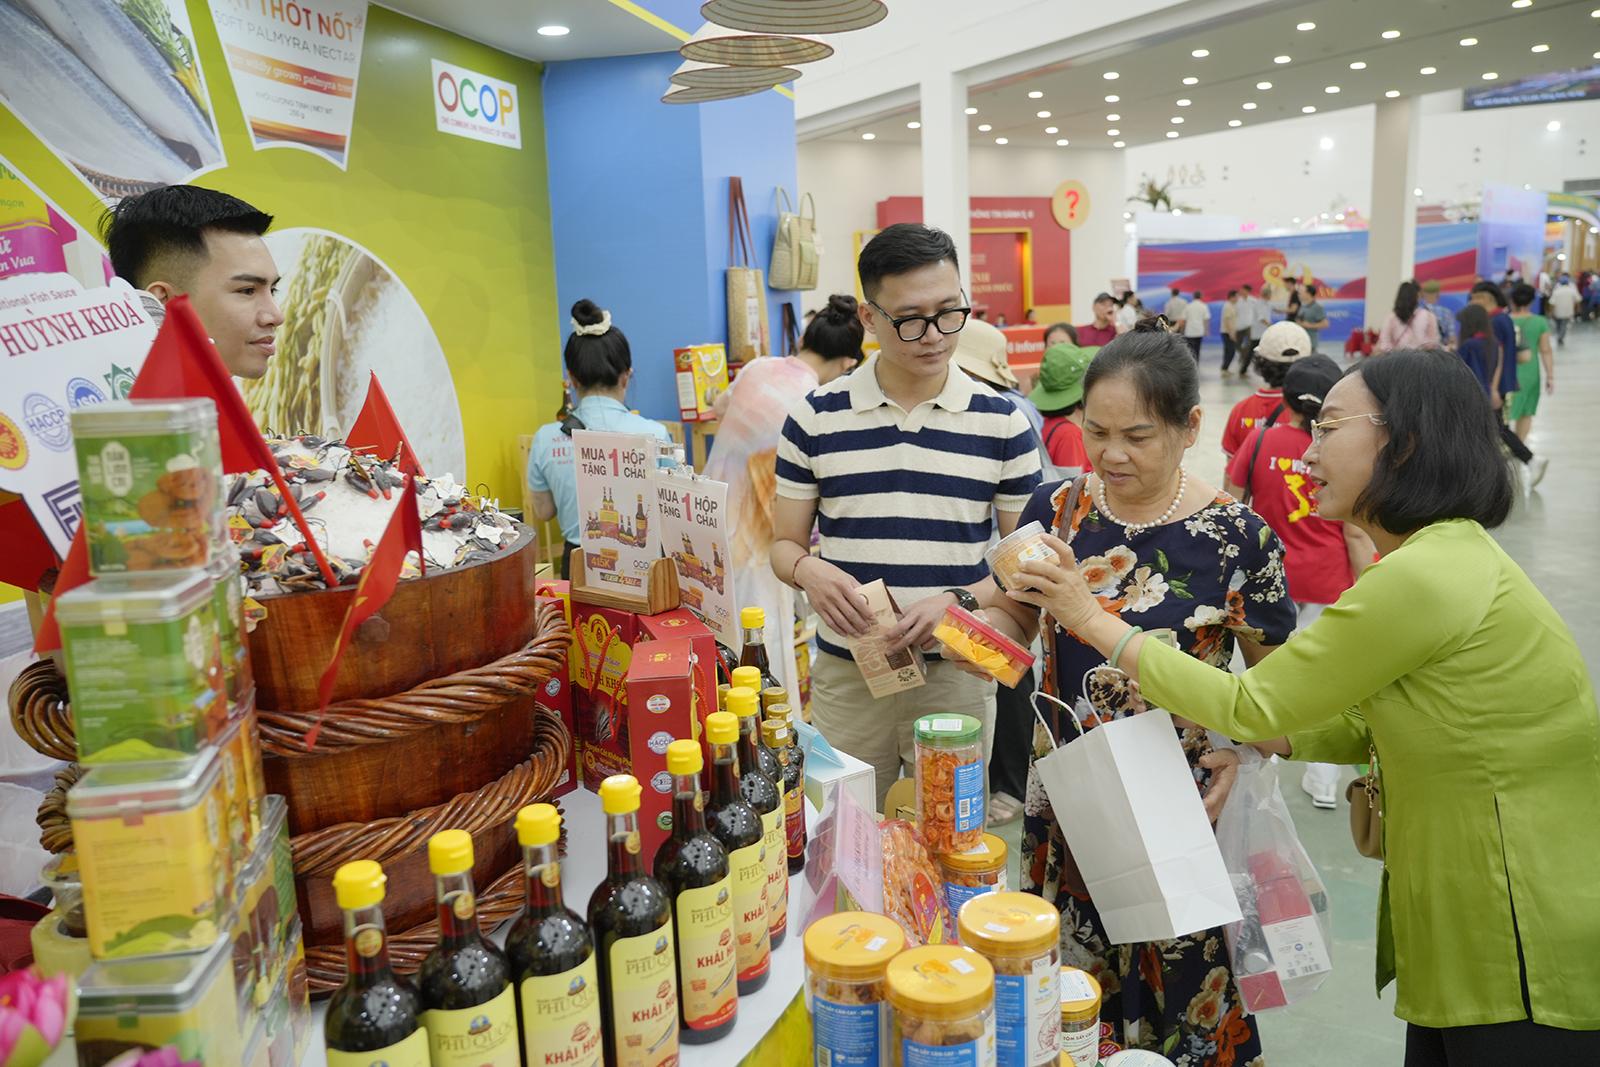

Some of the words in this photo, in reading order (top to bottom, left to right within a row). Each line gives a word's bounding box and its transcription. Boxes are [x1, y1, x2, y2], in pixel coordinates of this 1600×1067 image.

[248, 22, 310, 51] PALMYRA
[313, 44, 356, 64] NECTAR
[438, 71, 514, 127] OCOP
[13, 255, 36, 268] Vua
[0, 308, 86, 357] HUỲNH
[79, 299, 145, 337] KHOA
[25, 408, 66, 433] HACCP
[581, 448, 606, 461] MUA
[608, 448, 619, 477] 1
[622, 448, 646, 468] HỘP
[581, 461, 607, 477] TẶNG
[623, 467, 646, 479] CHAI
[1269, 456, 1277, 470] I
[656, 487, 679, 504] MUA
[681, 492, 692, 522] 1
[694, 495, 718, 515] HỘP
[658, 502, 681, 518] TẶNG
[696, 513, 718, 529] CHAI
[697, 949, 724, 969] KHẢI
[632, 1003, 662, 1023] KHẢI
[545, 1042, 578, 1065] KHẢI
